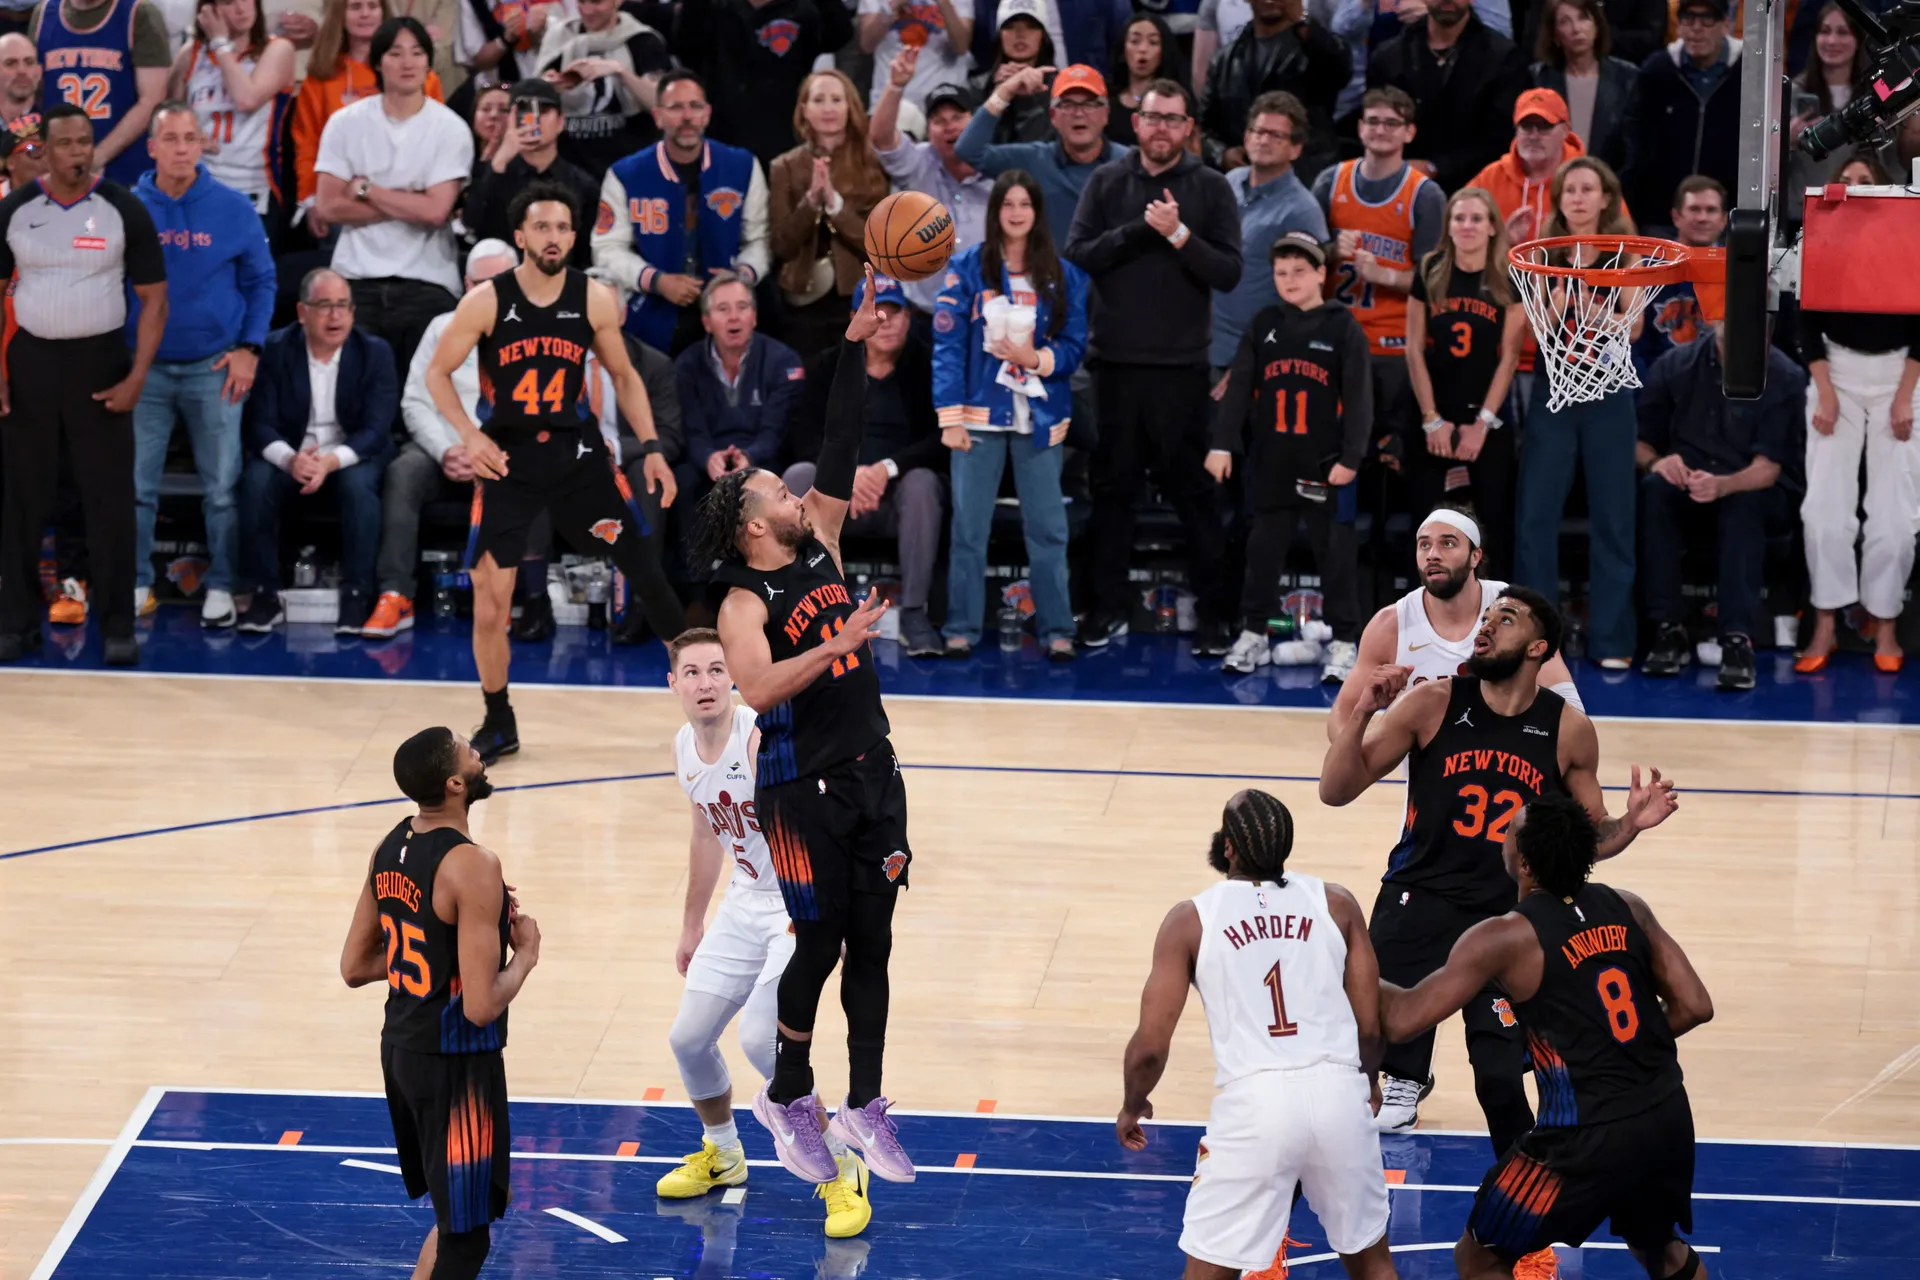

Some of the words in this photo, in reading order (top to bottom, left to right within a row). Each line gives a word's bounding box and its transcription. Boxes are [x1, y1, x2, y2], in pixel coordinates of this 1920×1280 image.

[57, 73, 111, 119] 32
[212, 111, 233, 143] 11
[630, 198, 668, 234] 46
[916, 213, 952, 243] Wilso
[1361, 232, 1408, 264] YORK
[1336, 261, 1374, 310] 21
[1463, 297, 1498, 323] YORK
[498, 337, 540, 367] NEW
[541, 336, 585, 365] YORK
[1449, 321, 1472, 358] 3
[512, 368, 567, 415] 44
[1264, 359, 1292, 381] NEW
[1293, 359, 1328, 386] YORK
[1275, 388, 1308, 434] 11
[783, 594, 819, 646] NEW
[810, 583, 852, 609] YORK
[1442, 749, 1494, 779] NEW
[1496, 751, 1544, 797] YORK
[1452, 783, 1524, 845] 32
[732, 843, 759, 881] 5
[375, 871, 423, 914] BRIDGES
[1223, 914, 1313, 951] HARDEN
[1561, 925, 1628, 970] ANUNOBY
[378, 911, 432, 999] 25
[1263, 959, 1298, 1037] 1
[1595, 965, 1641, 1045] 8
